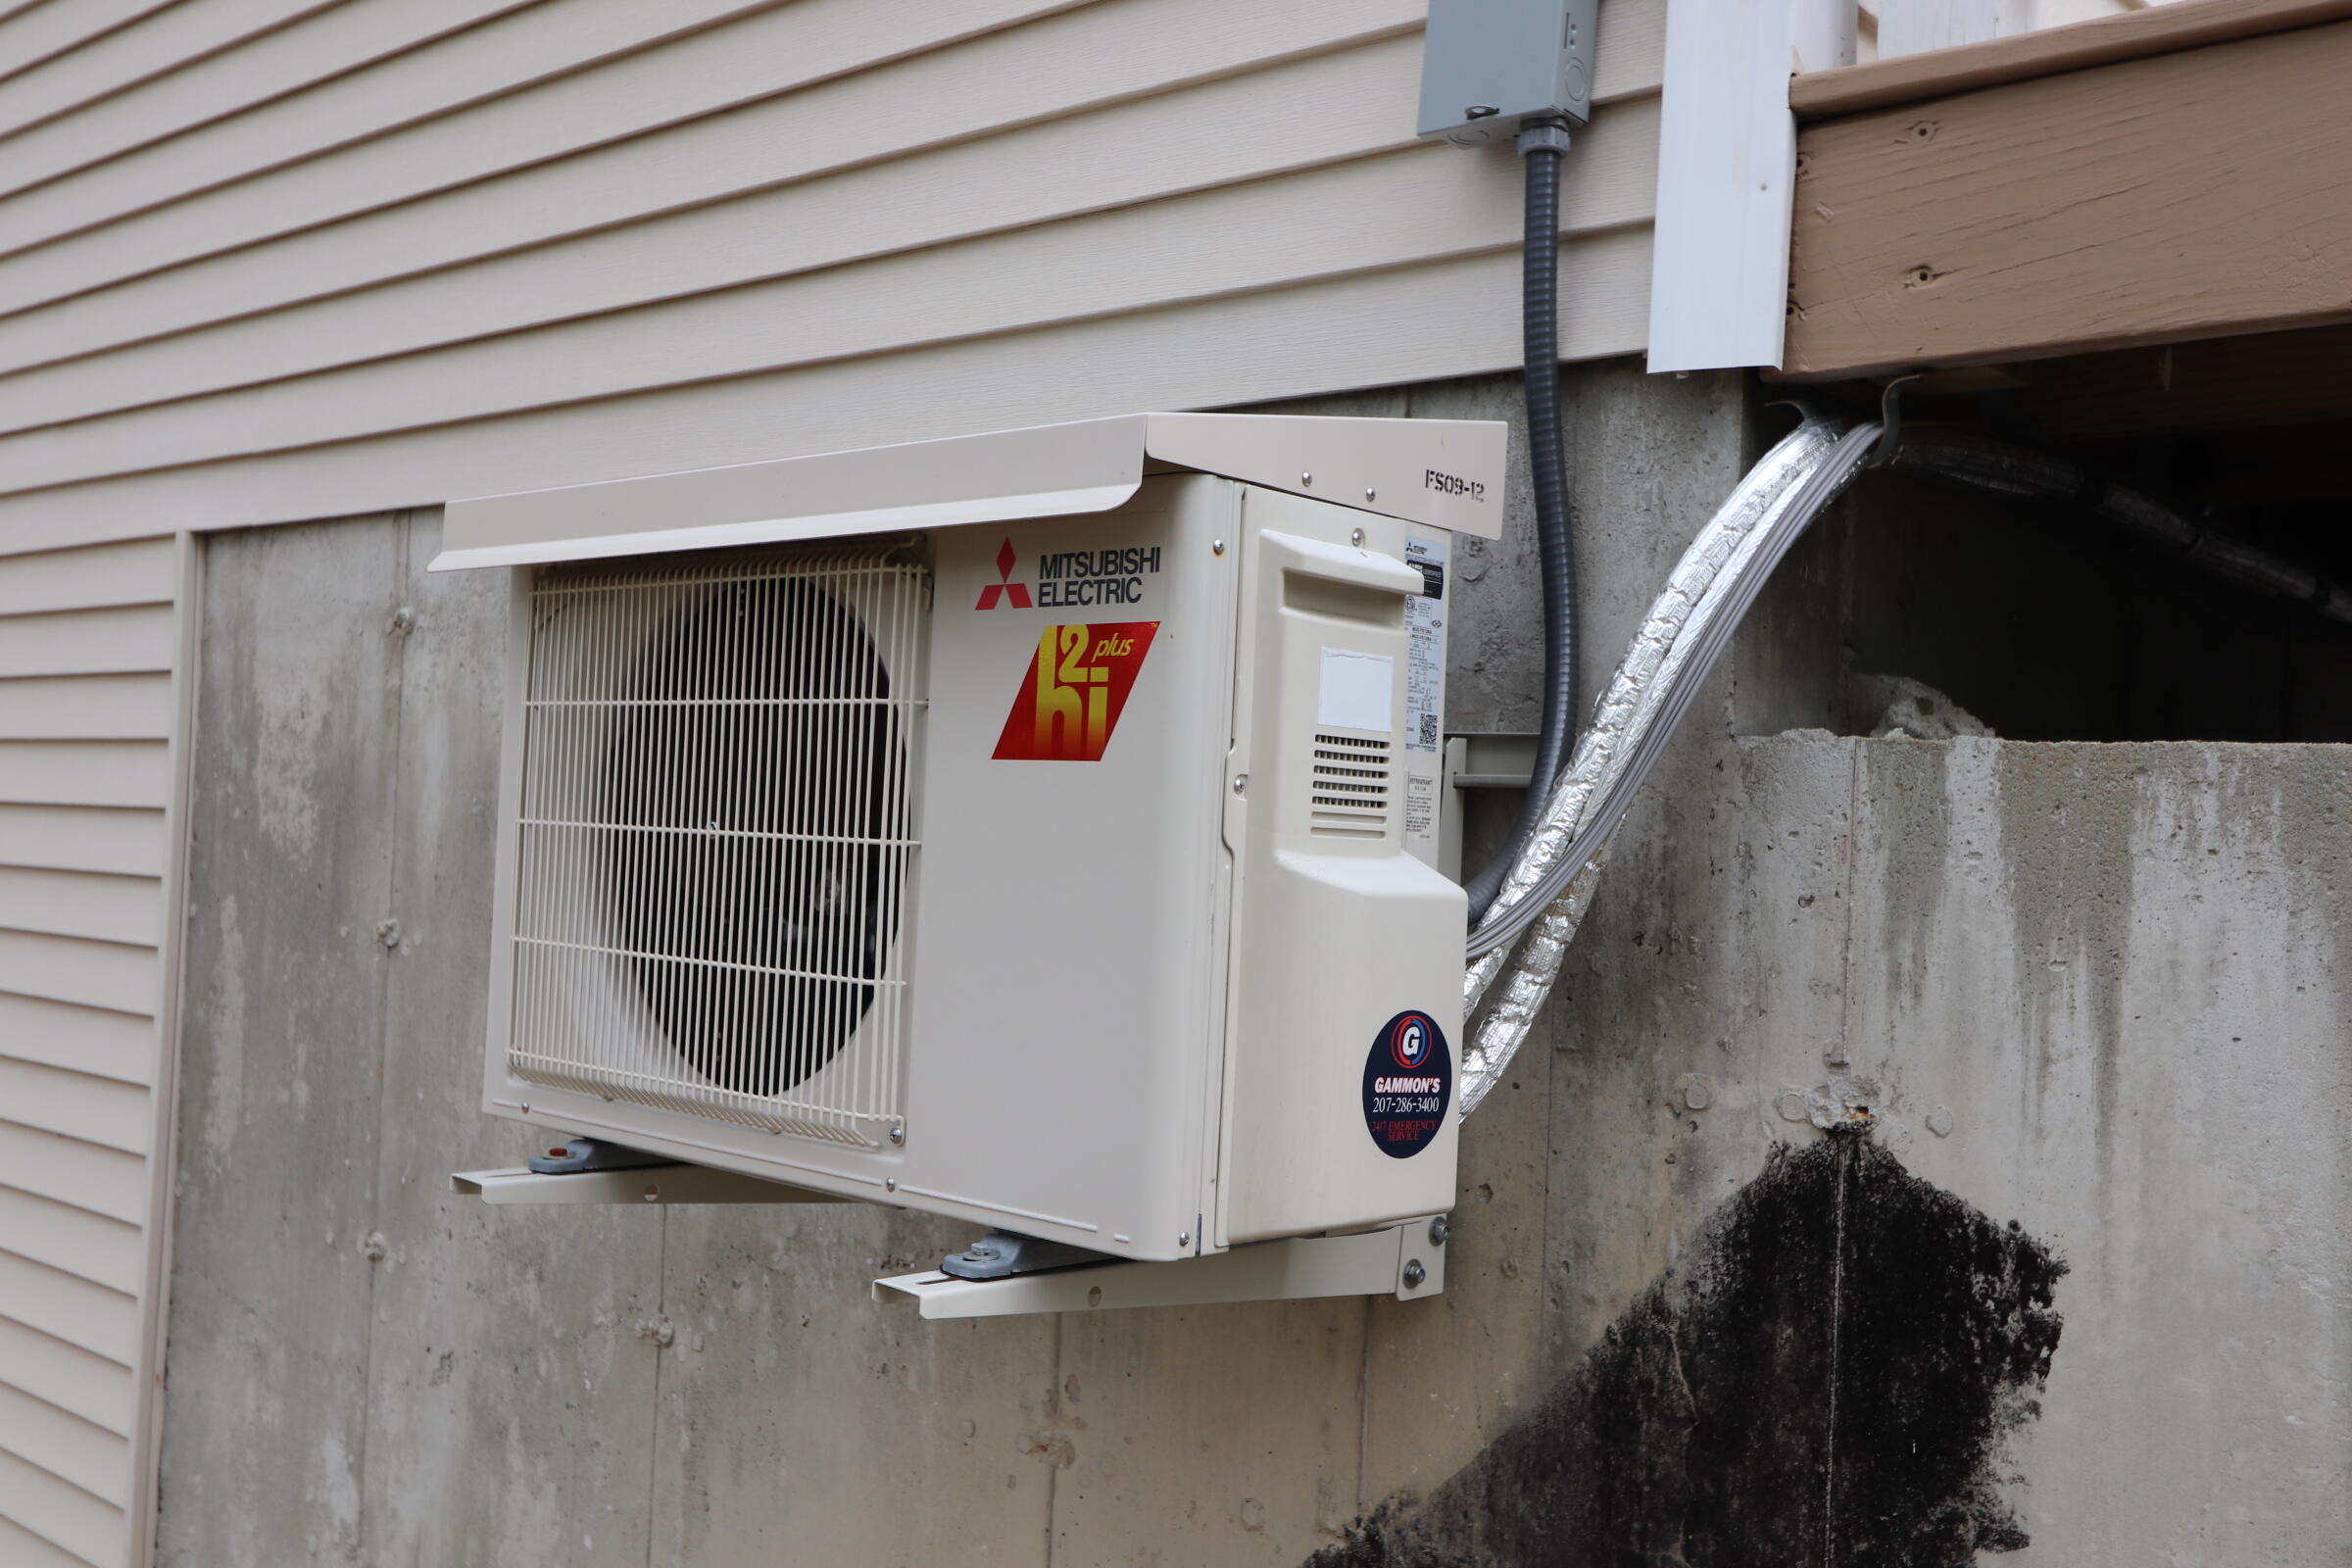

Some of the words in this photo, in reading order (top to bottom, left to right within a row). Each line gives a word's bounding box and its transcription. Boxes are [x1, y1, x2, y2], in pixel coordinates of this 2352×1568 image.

[1425, 469, 1484, 502] FS09-12
[1039, 546, 1161, 580] MITSUBISHI
[1038, 576, 1143, 608] ELECTRIC
[1091, 632, 1134, 663] plus
[1402, 1026, 1420, 1056] G
[1374, 1076, 1441, 1094] GAMMON'S
[1372, 1097, 1440, 1113] 207-286-3400
[1387, 1130, 1419, 1141] SERVICE
